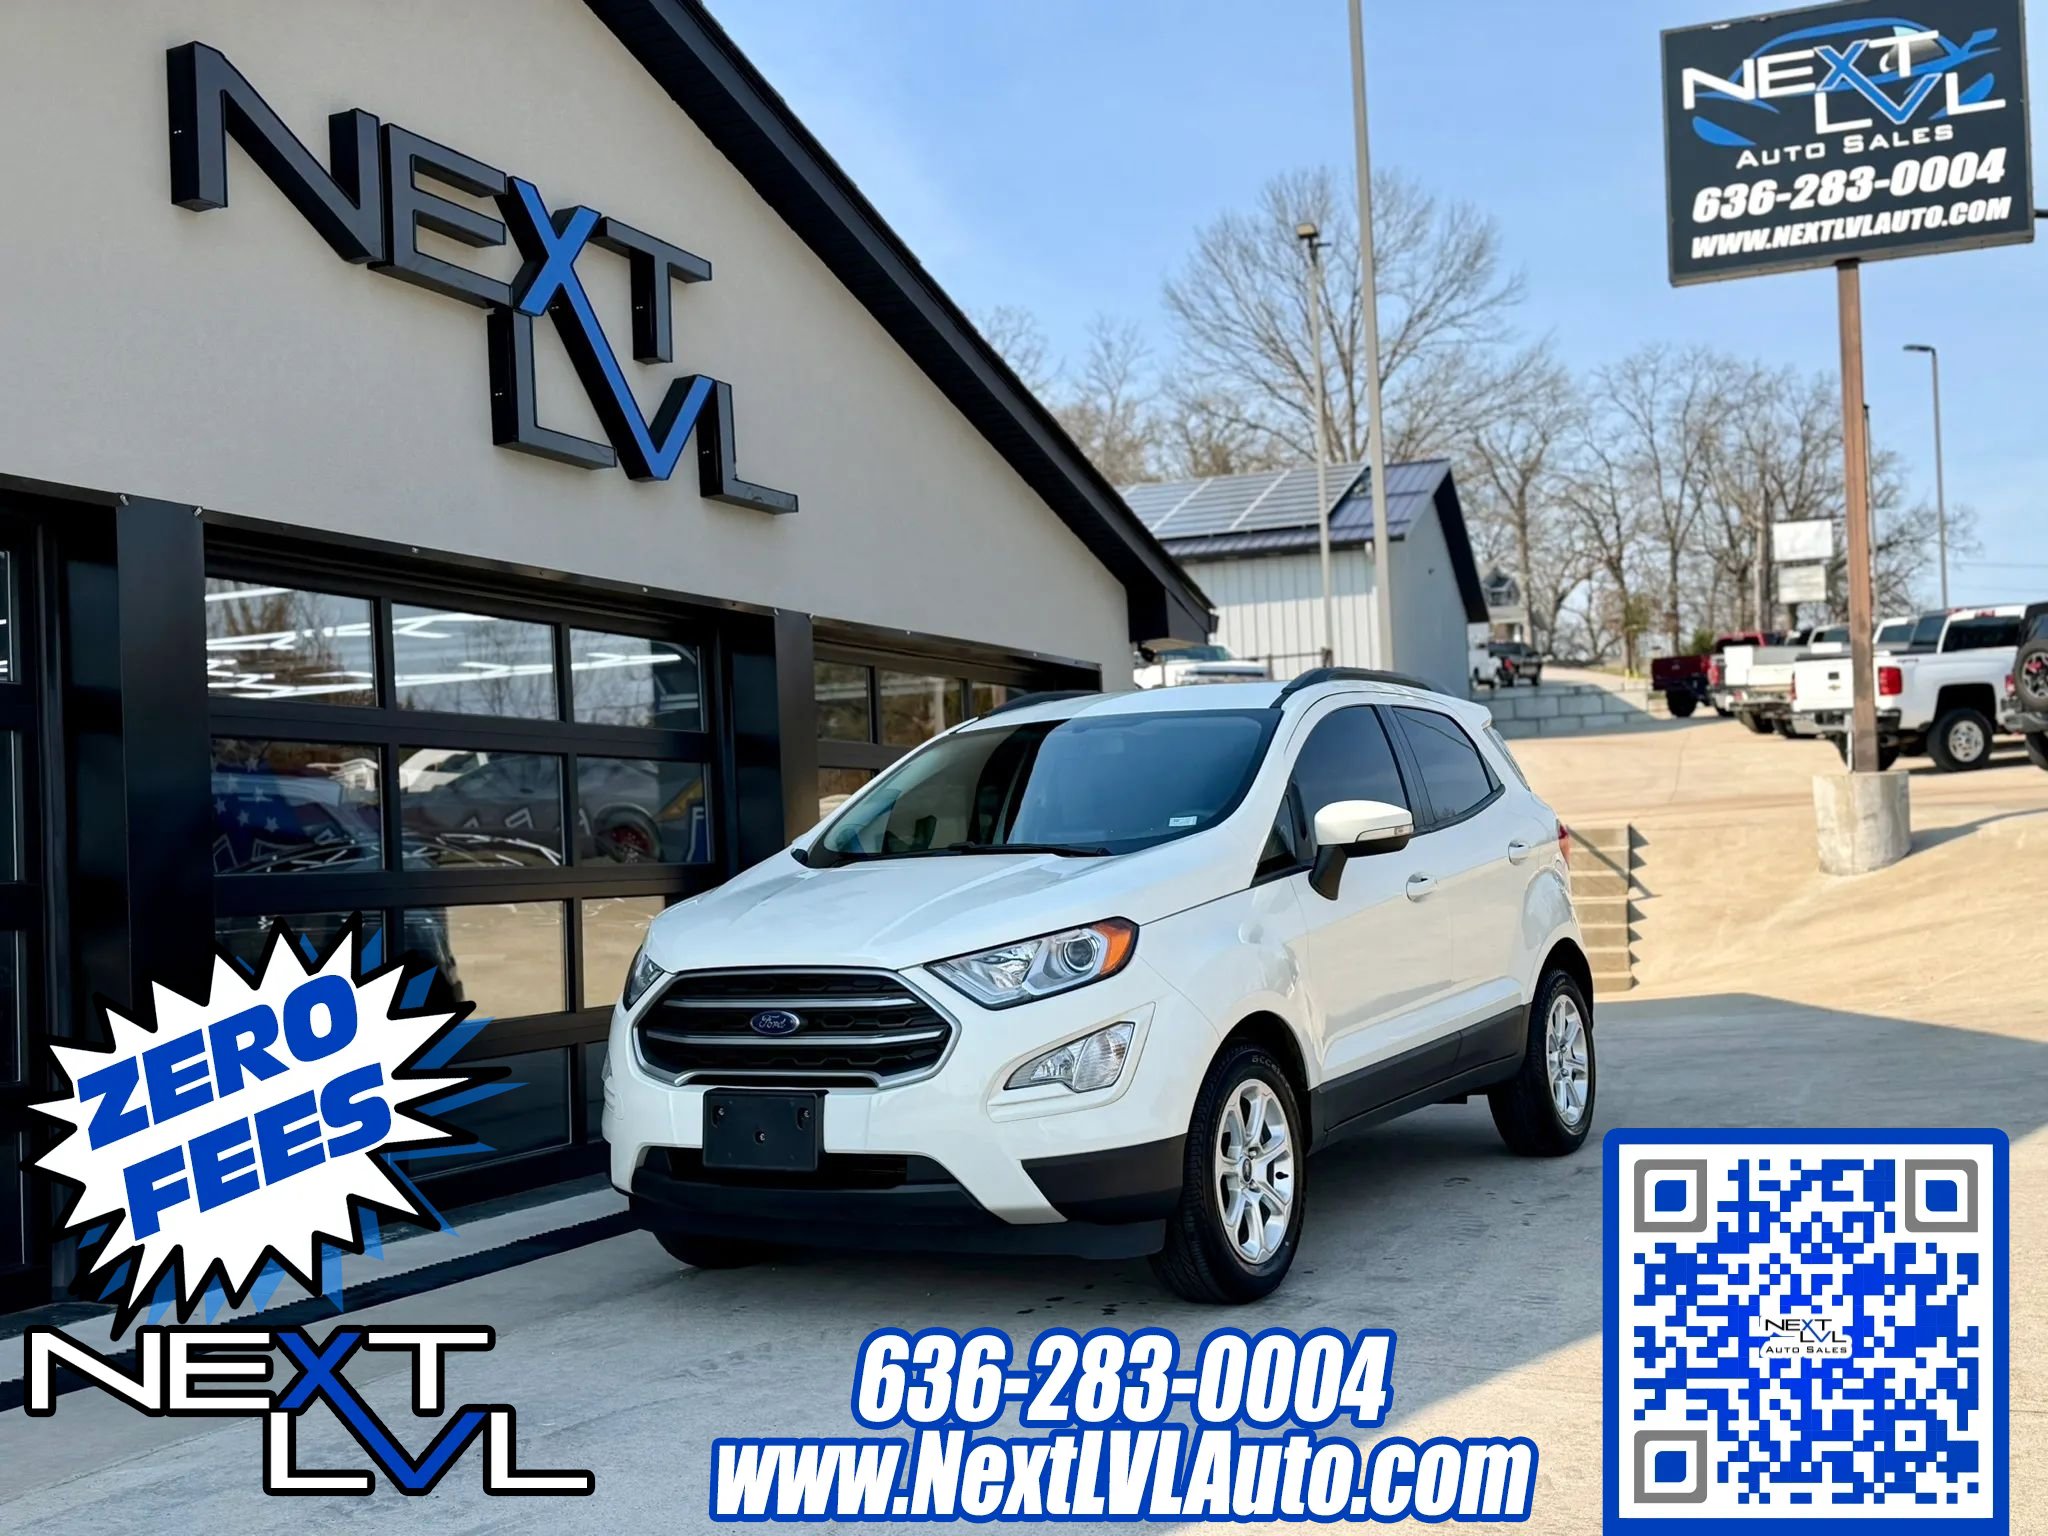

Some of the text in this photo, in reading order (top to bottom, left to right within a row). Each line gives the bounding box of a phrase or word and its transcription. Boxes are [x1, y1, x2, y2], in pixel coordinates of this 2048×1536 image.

[1682, 30, 1939, 110] NEXT
[1815, 73, 2006, 134] LVL
[167, 41, 712, 364] NEXT
[1692, 147, 2007, 224] 636-283-0004
[1691, 196, 2012, 259] WWW.NEXTLVLAUTO.COM
[487, 304, 799, 515] LVL
[758, 1014, 787, 1029] Ford
